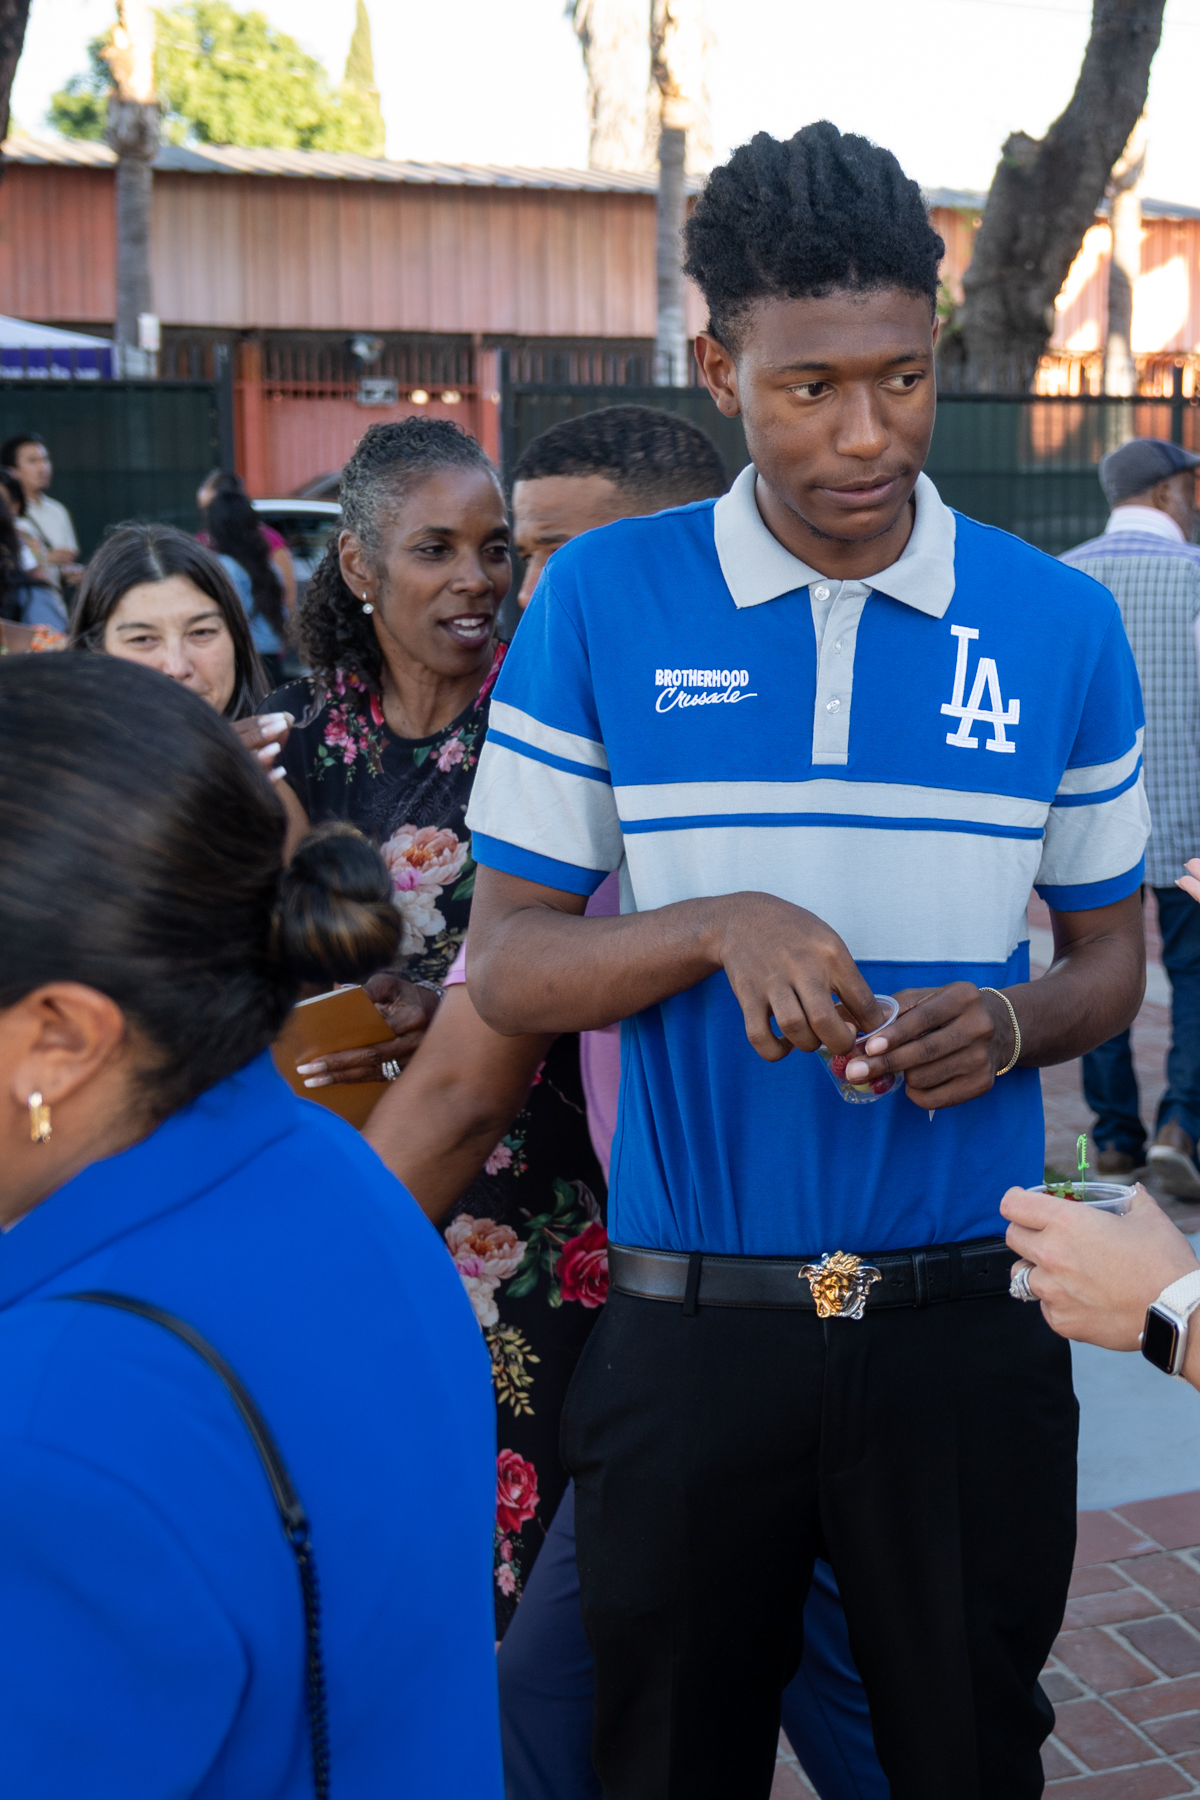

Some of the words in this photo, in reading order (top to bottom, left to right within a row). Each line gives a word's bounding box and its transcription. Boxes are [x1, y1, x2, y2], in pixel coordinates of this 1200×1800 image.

[655, 668, 750, 687] BROTHERHOOD
[940, 624, 1020, 754] LA
[655, 685, 758, 713] Crusade
